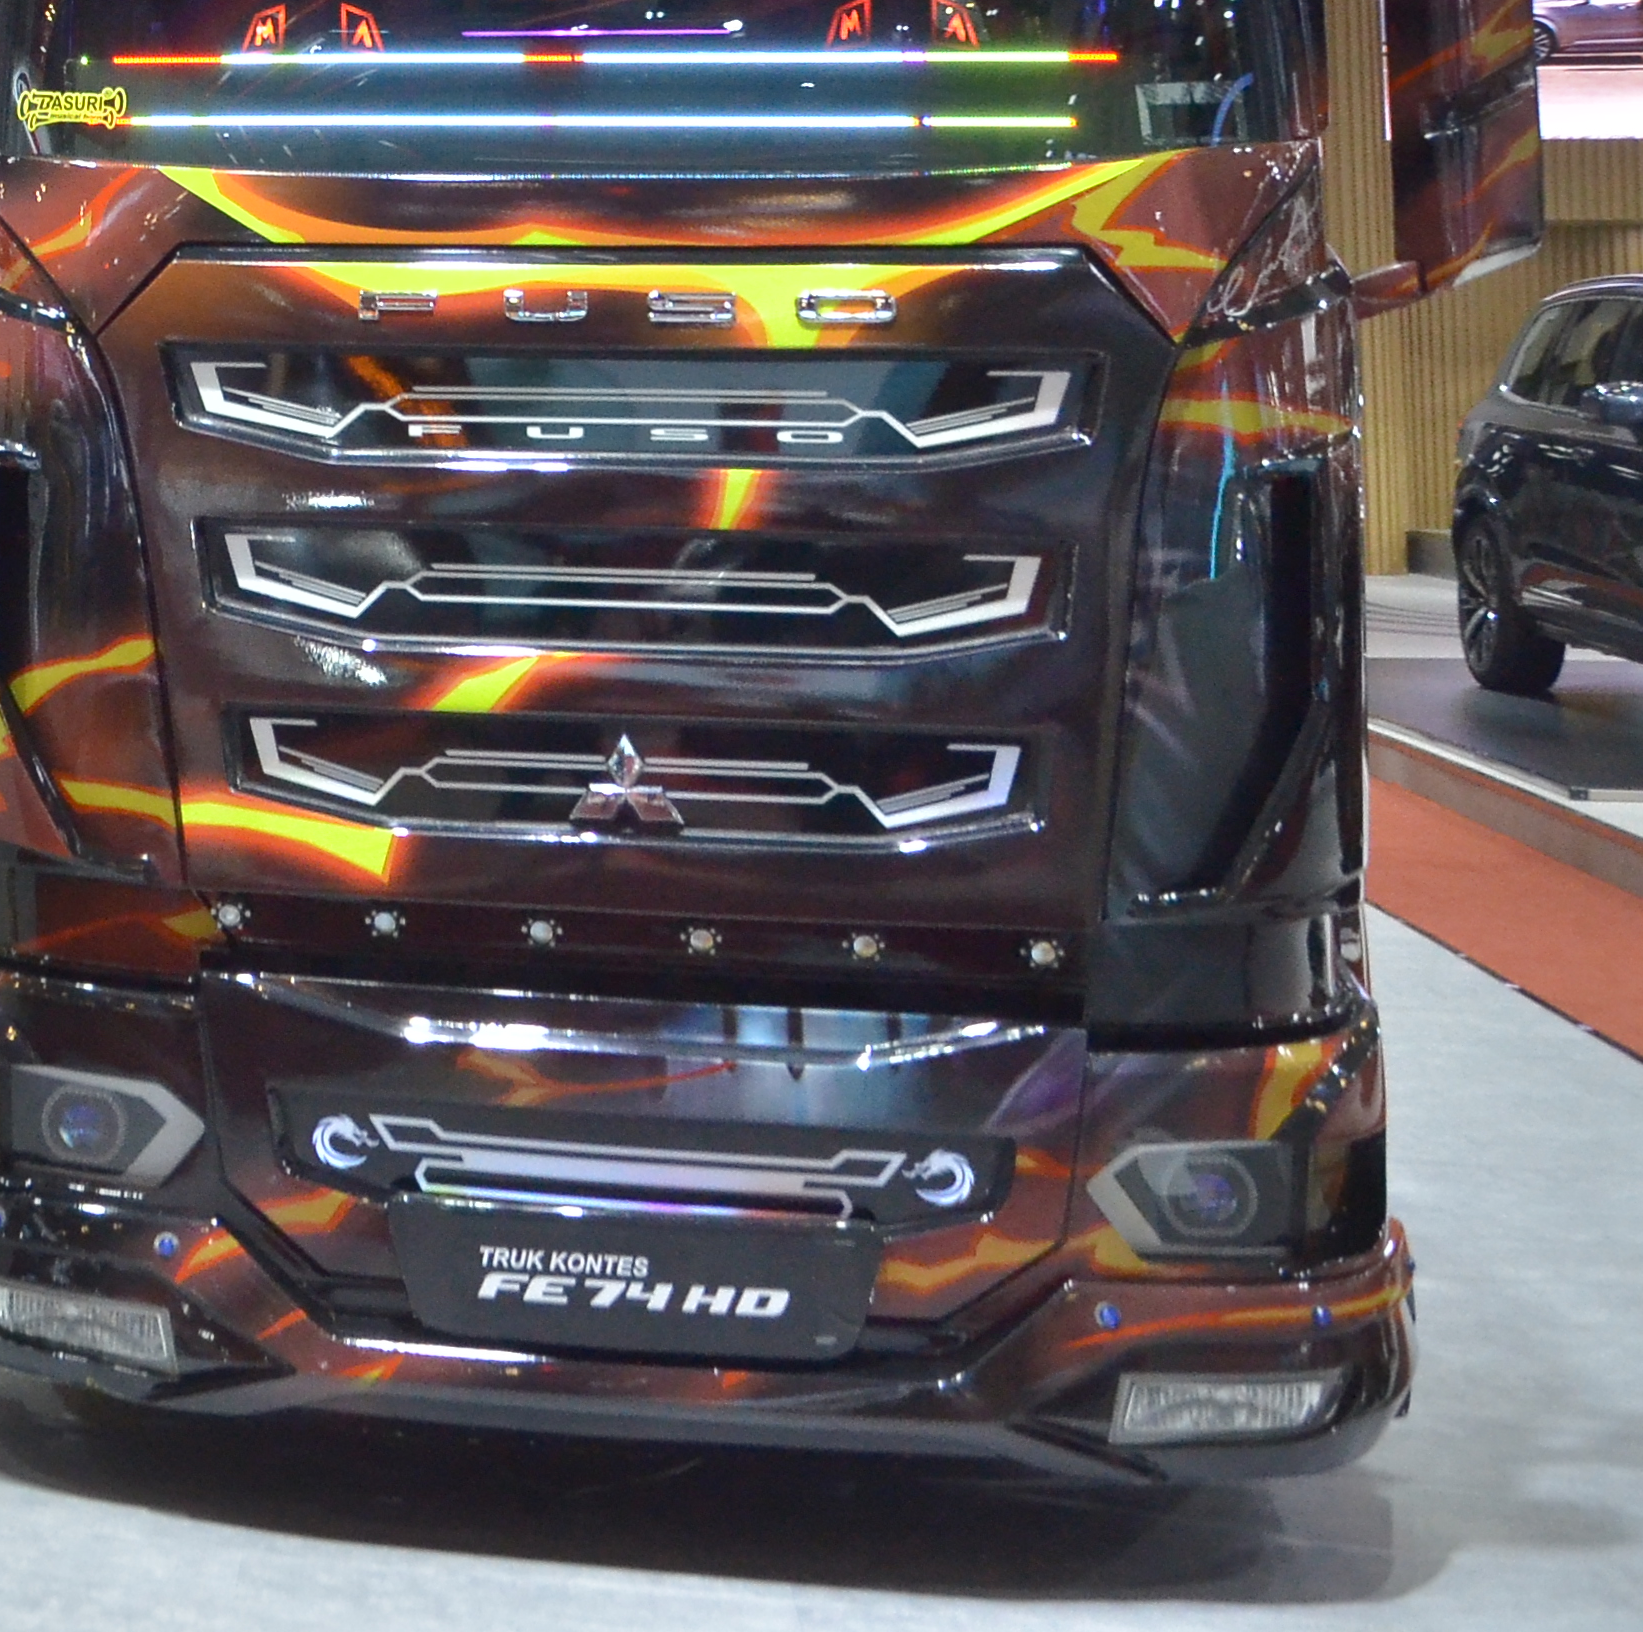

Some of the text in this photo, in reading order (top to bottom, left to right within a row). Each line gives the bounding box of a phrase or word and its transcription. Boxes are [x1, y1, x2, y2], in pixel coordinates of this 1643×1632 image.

[32, 94, 103, 111] BASURI
[358, 288, 899, 327] FUSO
[408, 423, 845, 446] FUSO
[479, 1245, 650, 1278] TRUK KONTES
[477, 1270, 792, 1319] FE 74 HD
